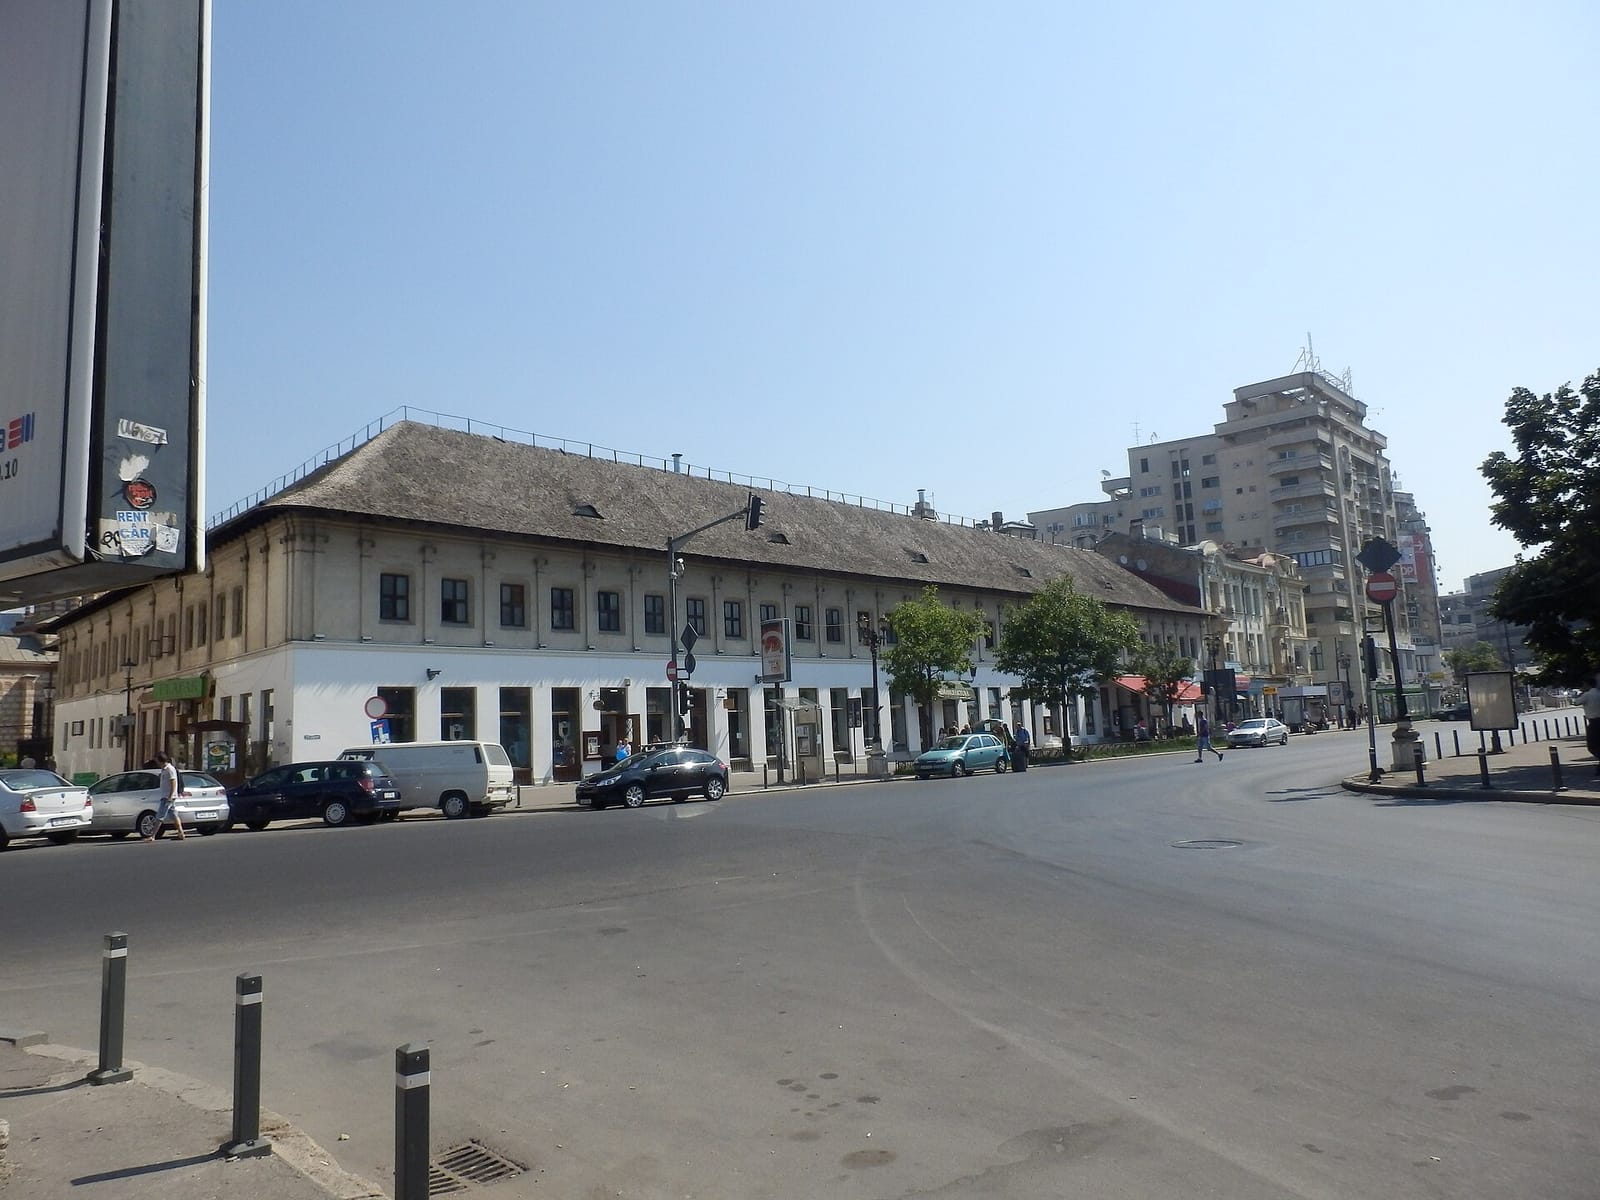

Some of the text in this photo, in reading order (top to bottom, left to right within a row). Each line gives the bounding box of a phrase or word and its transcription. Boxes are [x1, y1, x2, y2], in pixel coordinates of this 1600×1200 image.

[0, 458, 18, 480] .10
[117, 511, 148, 522] RENT
[119, 528, 150, 539] CAR
